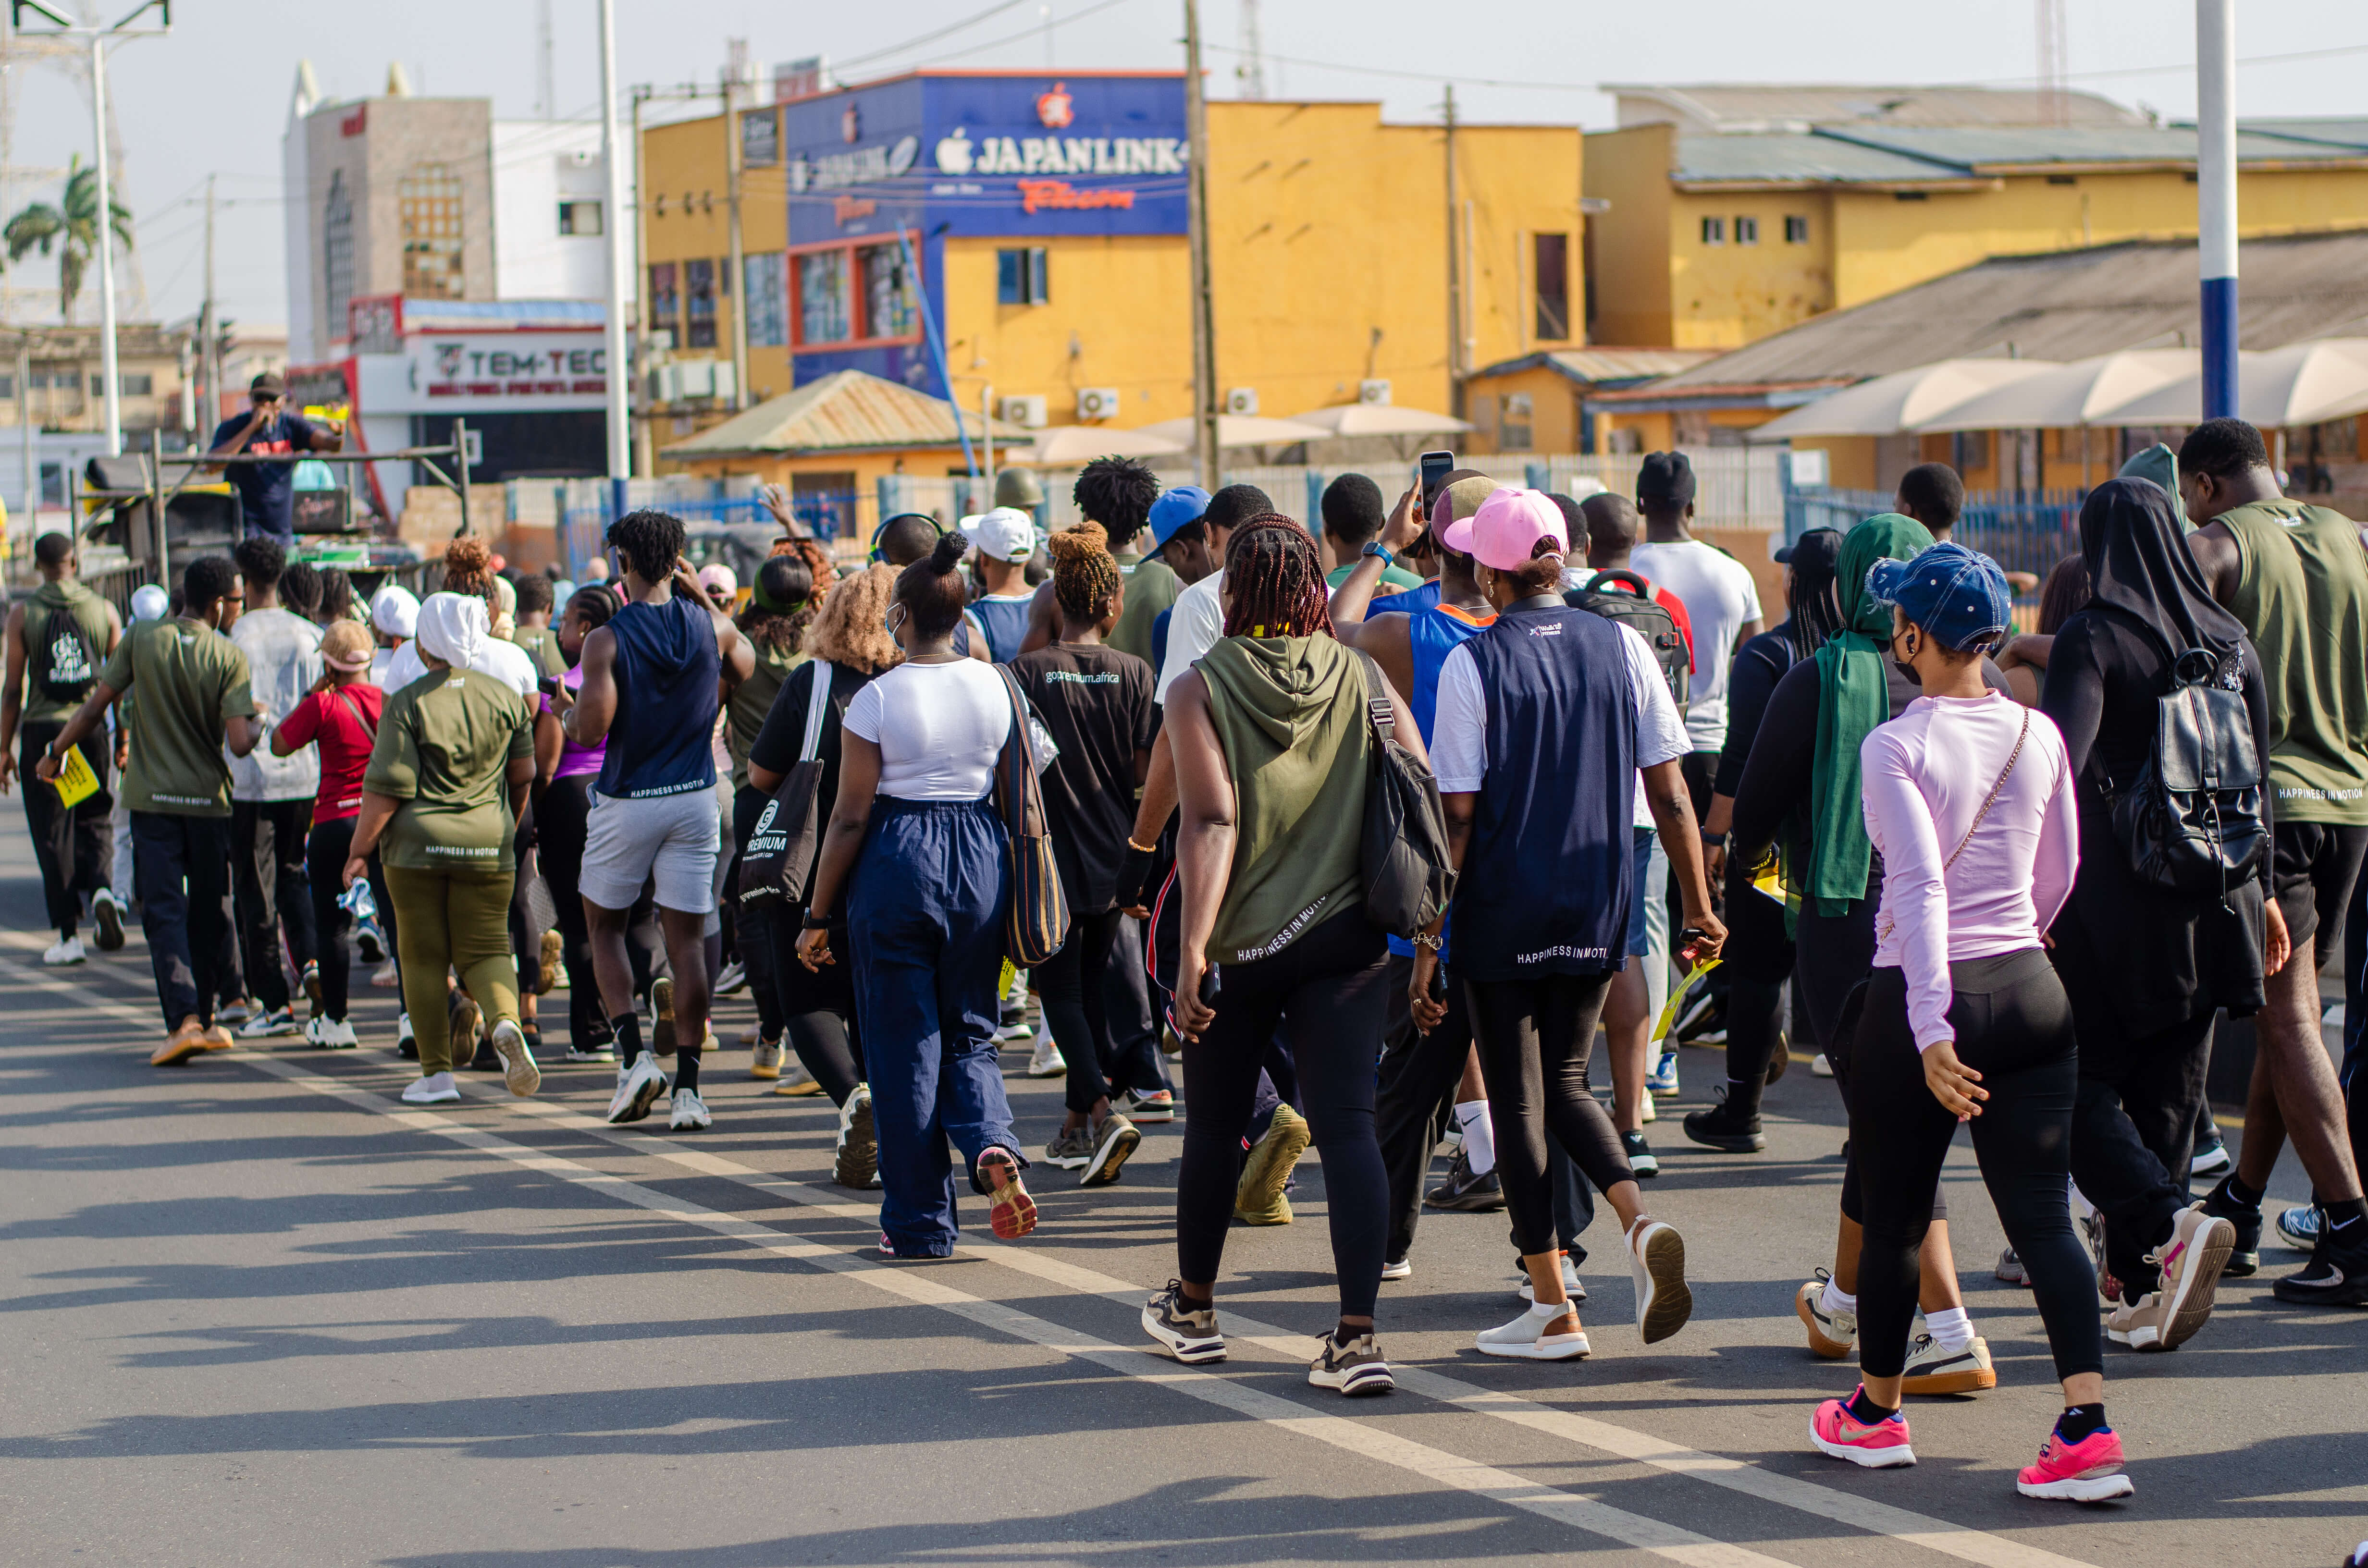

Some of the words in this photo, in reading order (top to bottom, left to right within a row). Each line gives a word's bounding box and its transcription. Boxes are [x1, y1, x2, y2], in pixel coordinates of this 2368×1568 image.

[976, 137, 1184, 174] JAPANLINK
[1046, 671, 1120, 683] gopremium.africa
[631, 785, 672, 798] HAPPINESS
[2279, 788, 2325, 799] HAPPINESS
[2328, 790, 2336, 800] IN
[2336, 788, 2363, 801] MOTION
[426, 845, 465, 856] HAPPINESS
[466, 847, 474, 856] IN
[474, 847, 500, 857] MOTION
[1238, 929, 1293, 961] HAPPINESS
[1290, 919, 1303, 933] IN
[1517, 945, 1571, 964] HAPPINESS
[1573, 947, 1583, 959] IN
